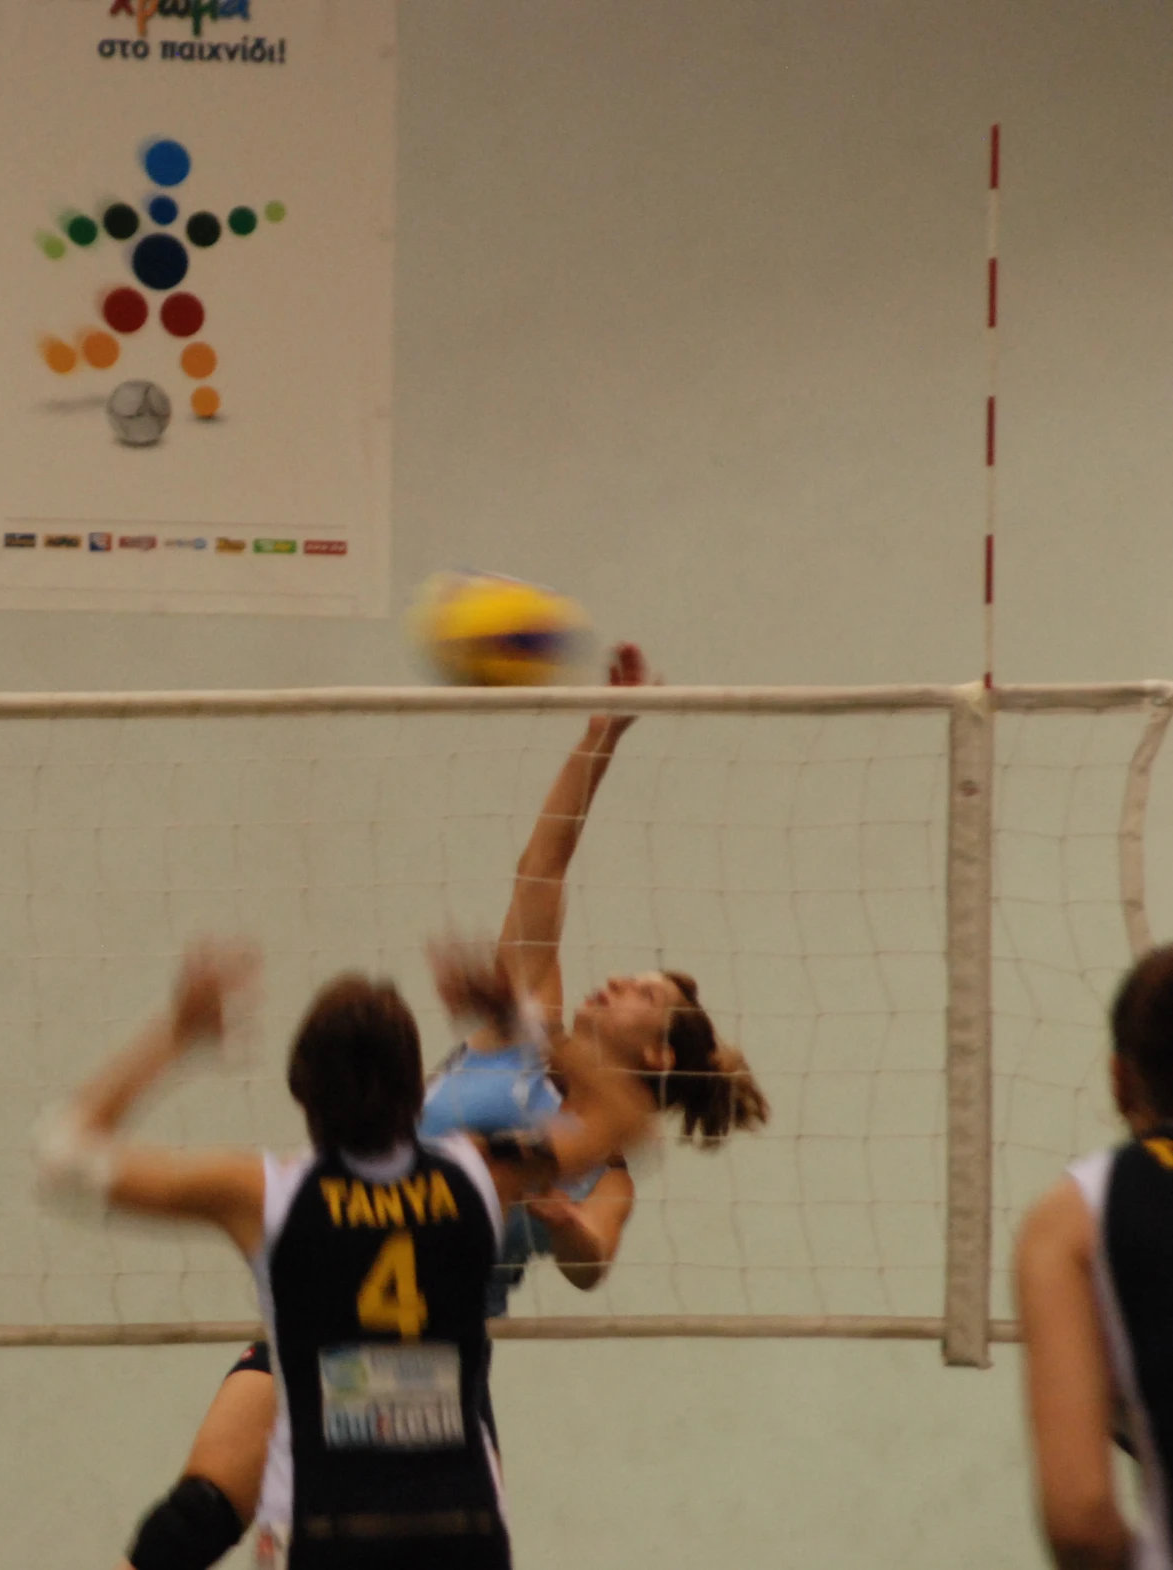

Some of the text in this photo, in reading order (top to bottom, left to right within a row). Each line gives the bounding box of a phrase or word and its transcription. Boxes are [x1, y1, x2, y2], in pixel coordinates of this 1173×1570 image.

[98, 35, 286, 64] στο παιχνίδι!
[319, 1169, 460, 1229] TANYA
[356, 1230, 428, 1344] 4
